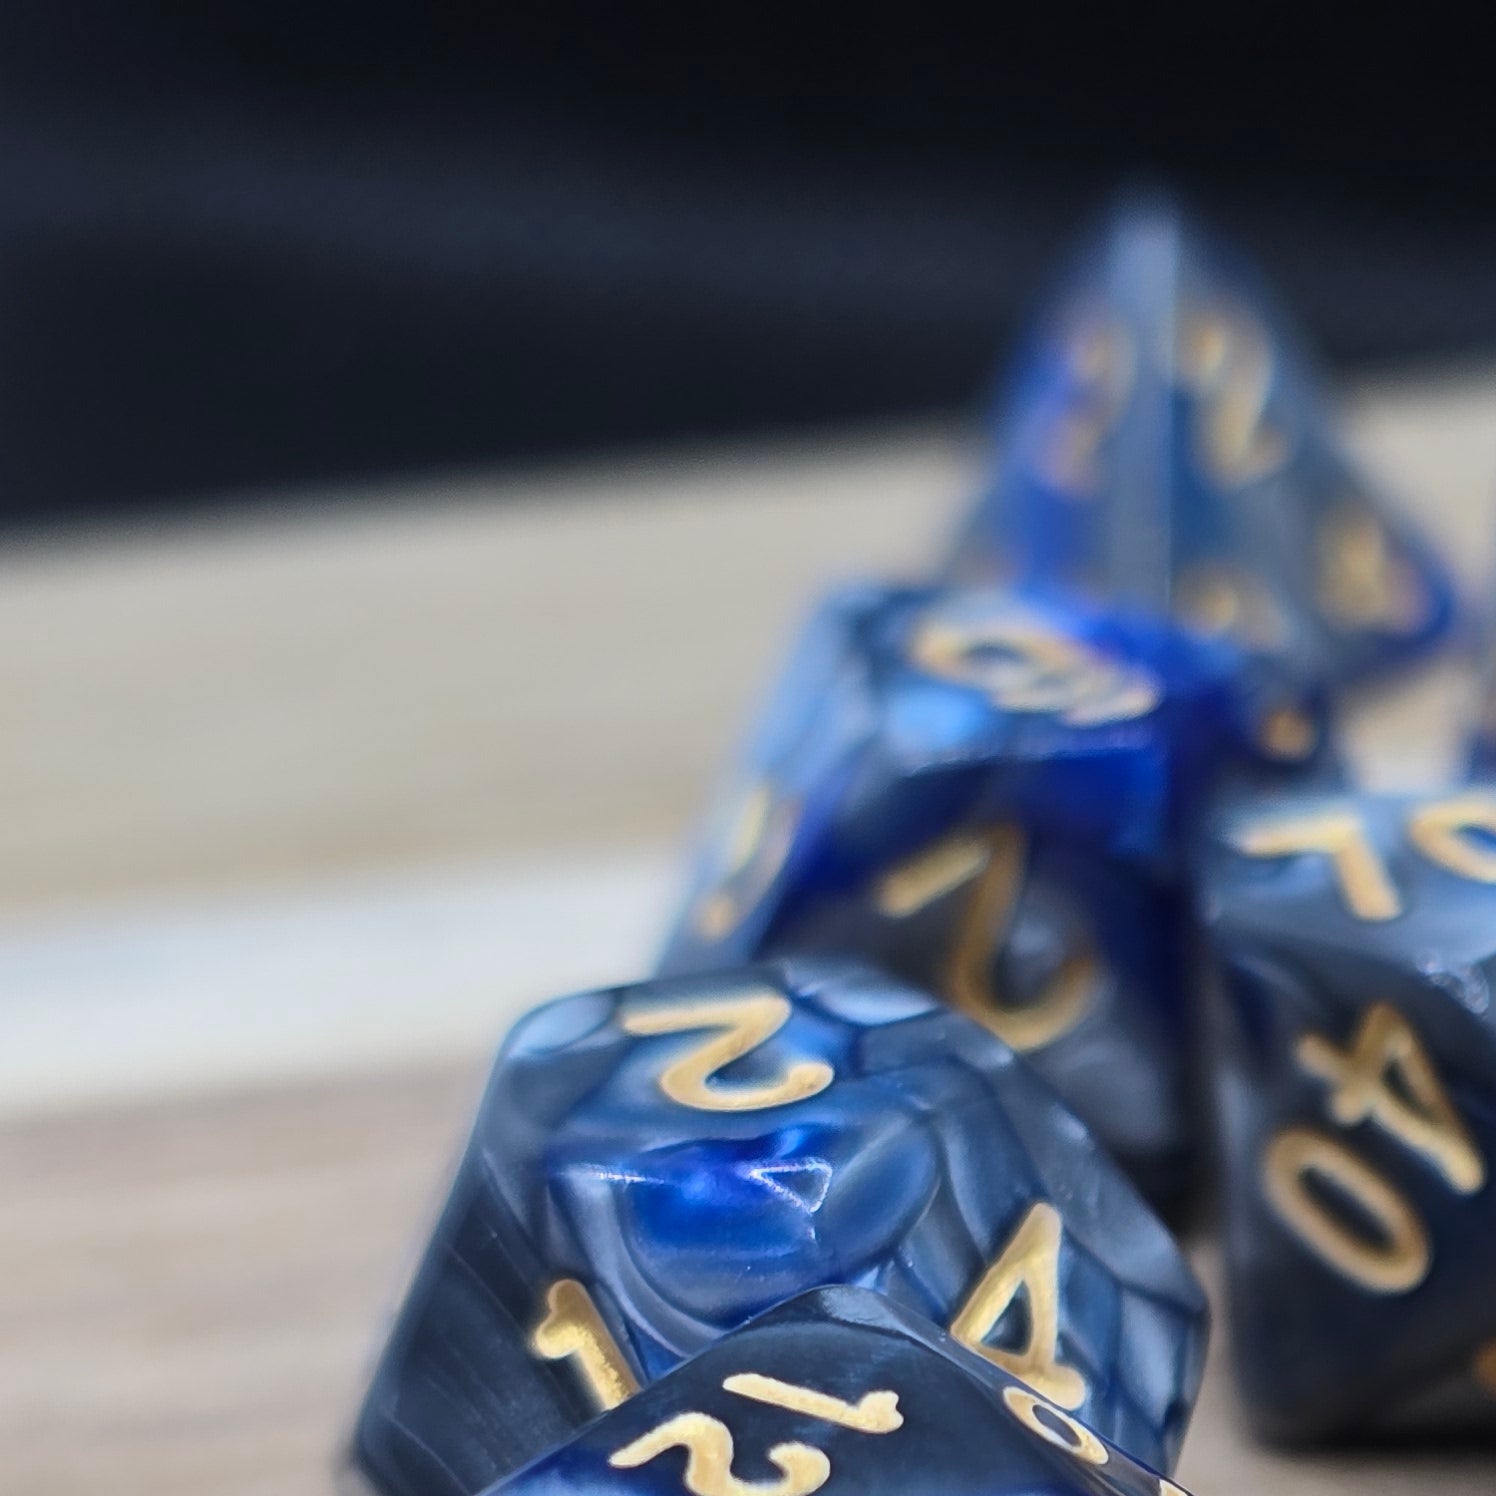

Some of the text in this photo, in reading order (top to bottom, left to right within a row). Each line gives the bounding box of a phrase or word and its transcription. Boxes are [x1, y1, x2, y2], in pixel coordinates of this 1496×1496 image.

[621, 990, 835, 1111] 2
[1262, 1002, 1485, 1293] 40
[950, 1202, 1087, 1411] 4
